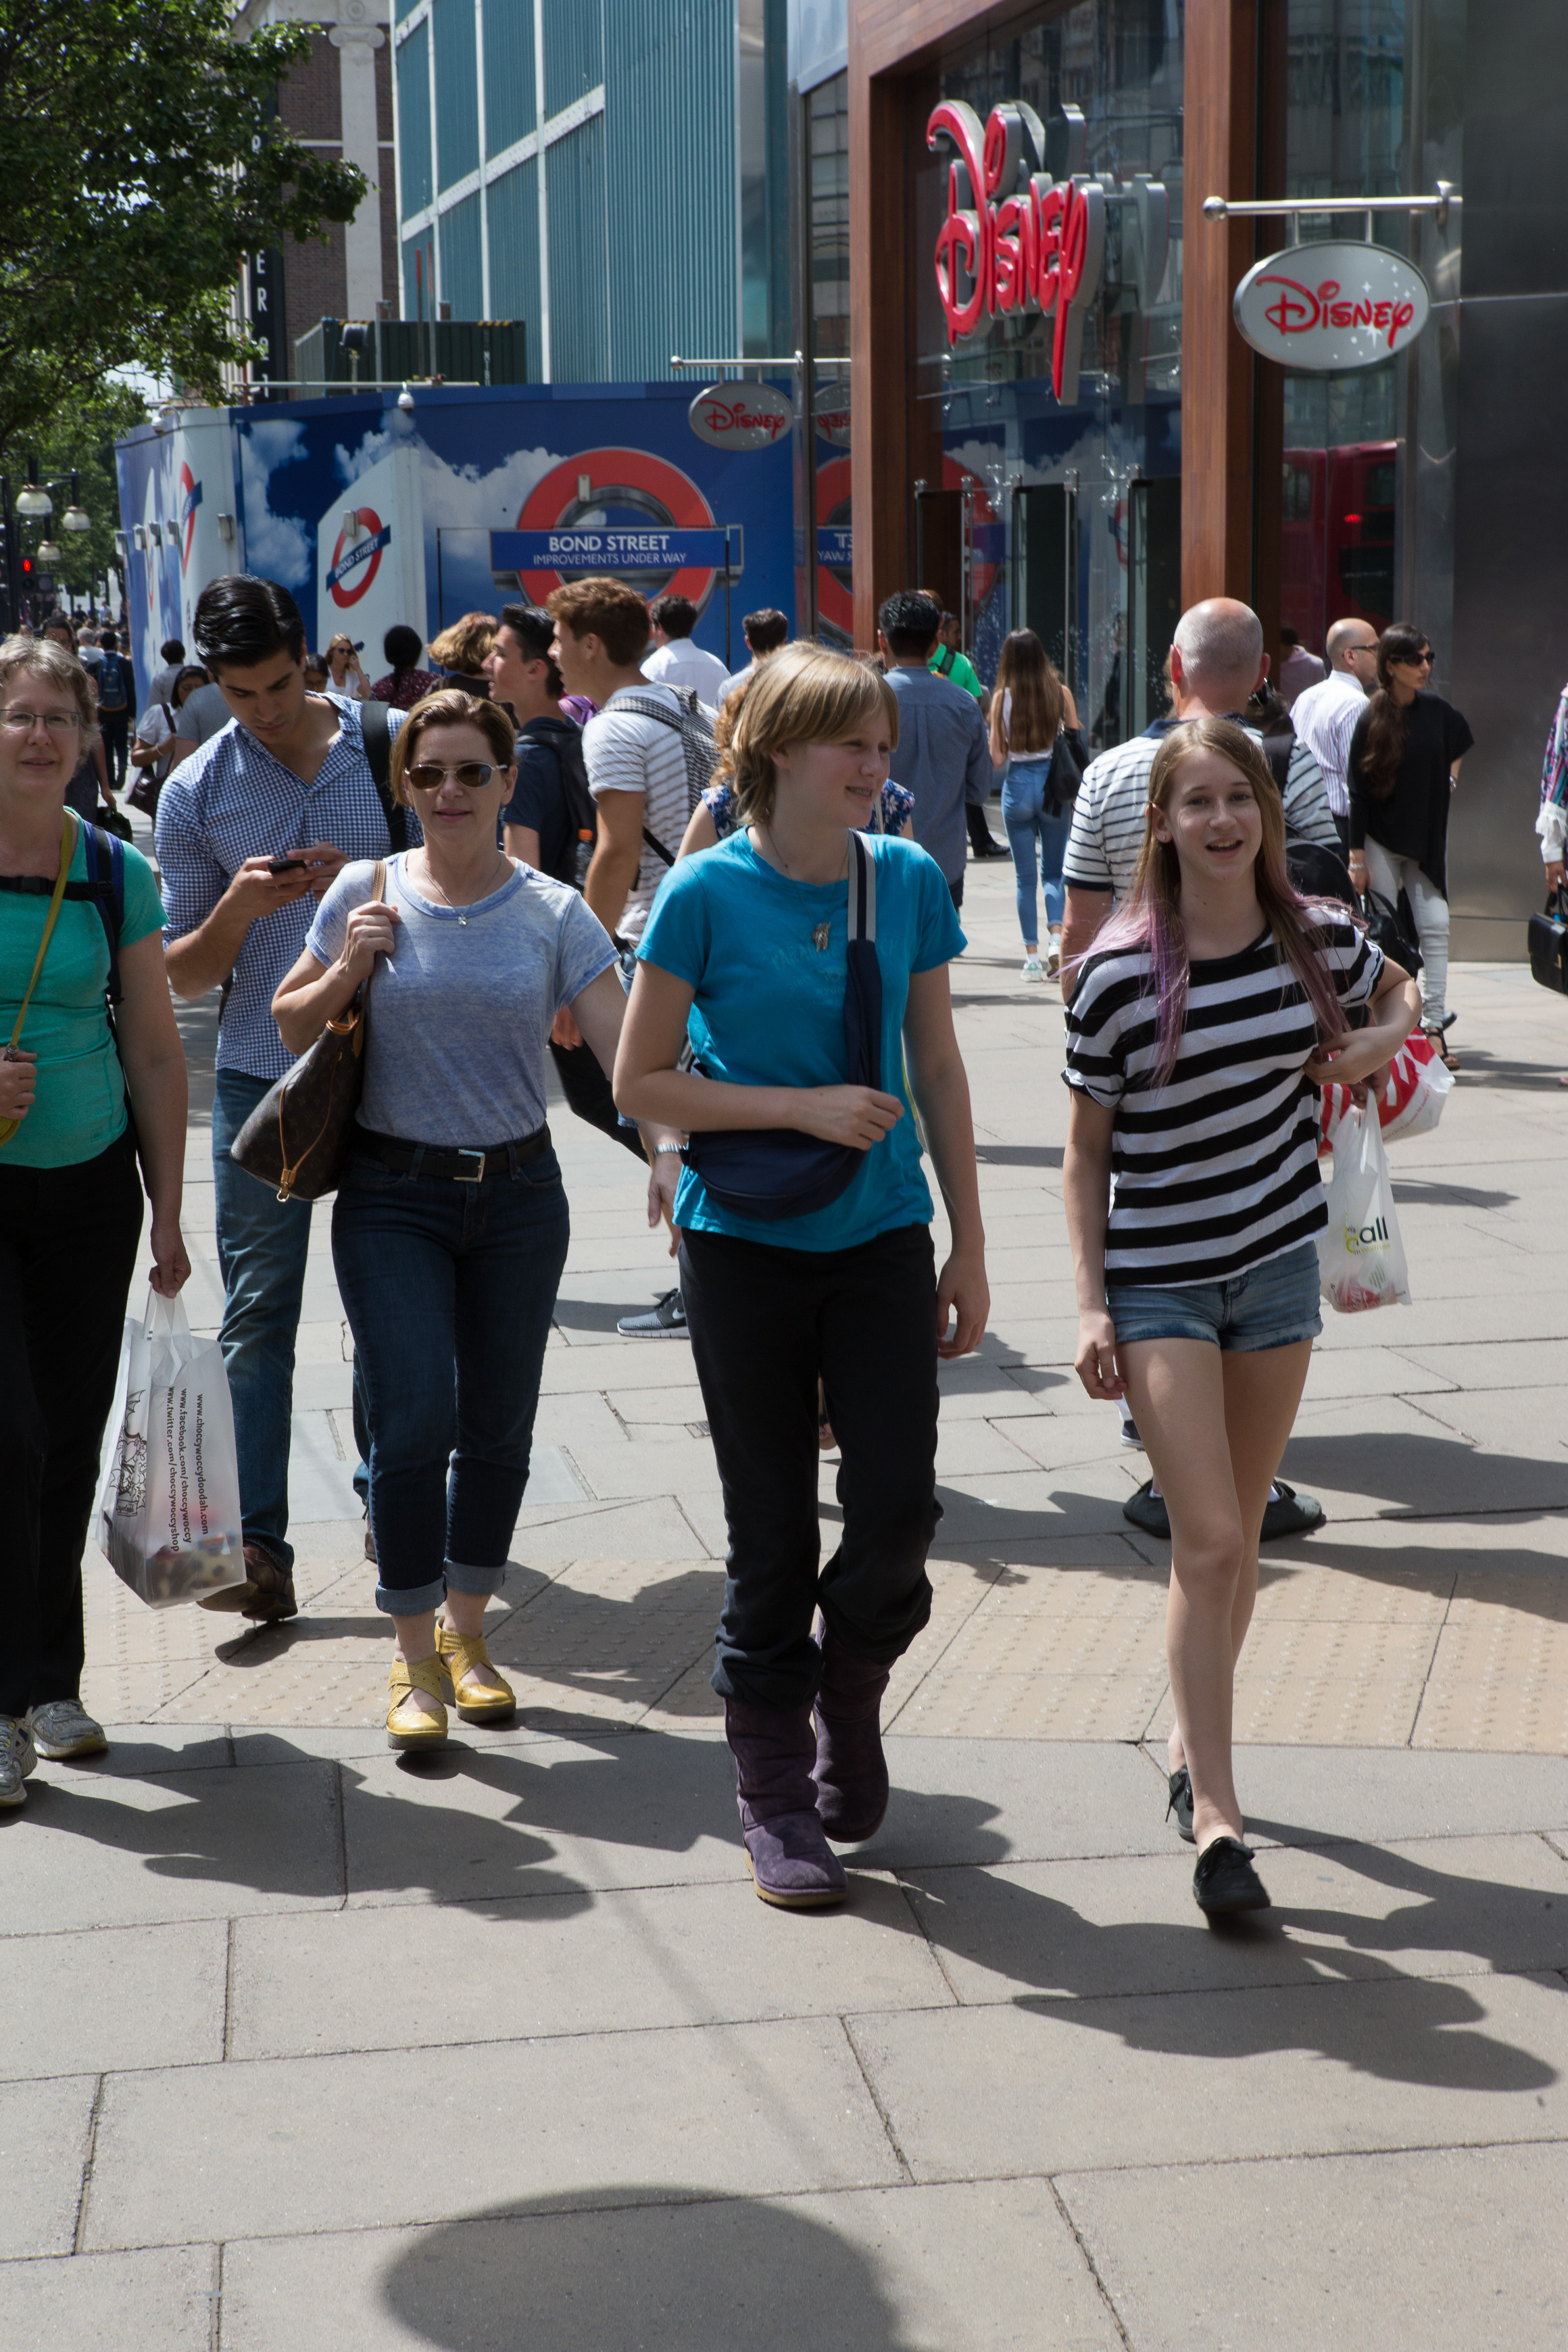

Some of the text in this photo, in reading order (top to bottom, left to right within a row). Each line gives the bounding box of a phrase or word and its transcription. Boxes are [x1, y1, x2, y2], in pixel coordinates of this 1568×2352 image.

[355, 537, 380, 562] STREET
[533, 552, 687, 565] IMPROVEMENTS UNDER WAY
[549, 535, 670, 552] BOND STREET
[166, 1386, 180, 1552] www.twitter.com/choccywoccyshop
[178, 1388, 193, 1544] www.facebook.com/choccywoccy
[194, 1393, 209, 1535] www.choccywoccydoodah.com
